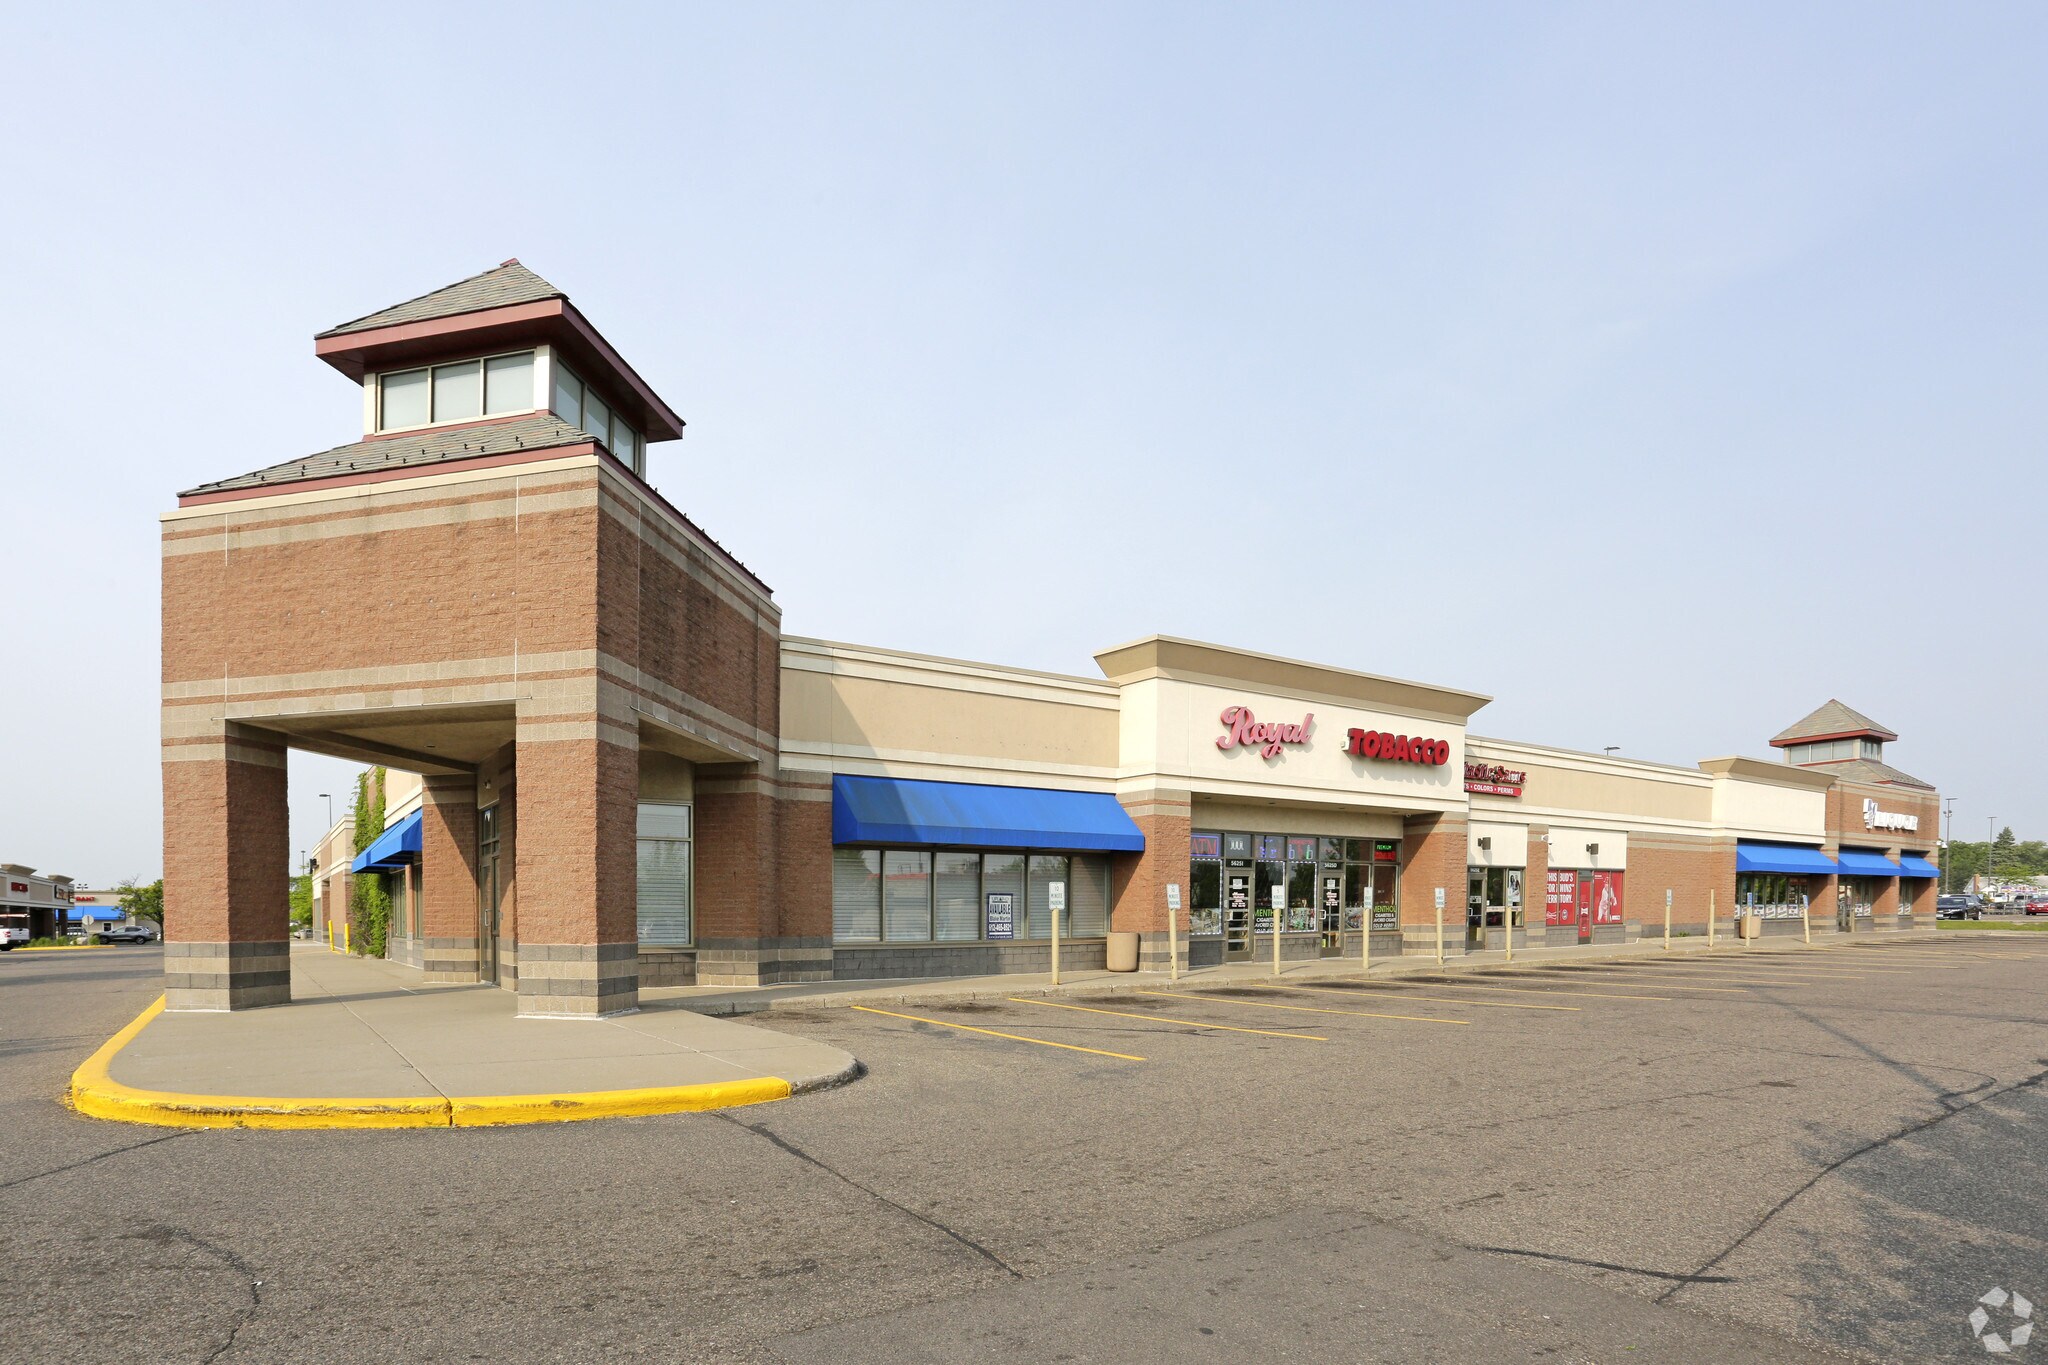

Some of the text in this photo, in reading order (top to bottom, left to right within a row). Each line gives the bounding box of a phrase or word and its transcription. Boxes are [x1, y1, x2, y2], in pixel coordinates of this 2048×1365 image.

[1215, 705, 1450, 766] Royal TOBACCO
[1473, 784, 1493, 792] COLORS
[1873, 811, 1918, 831] LIQUOR
[1191, 838, 1216, 854] ATM
[1547, 872, 1573, 882] THIS BUD'S
[990, 904, 1011, 915] AVAILABLE
[1255, 909, 1283, 917] MENTHL
